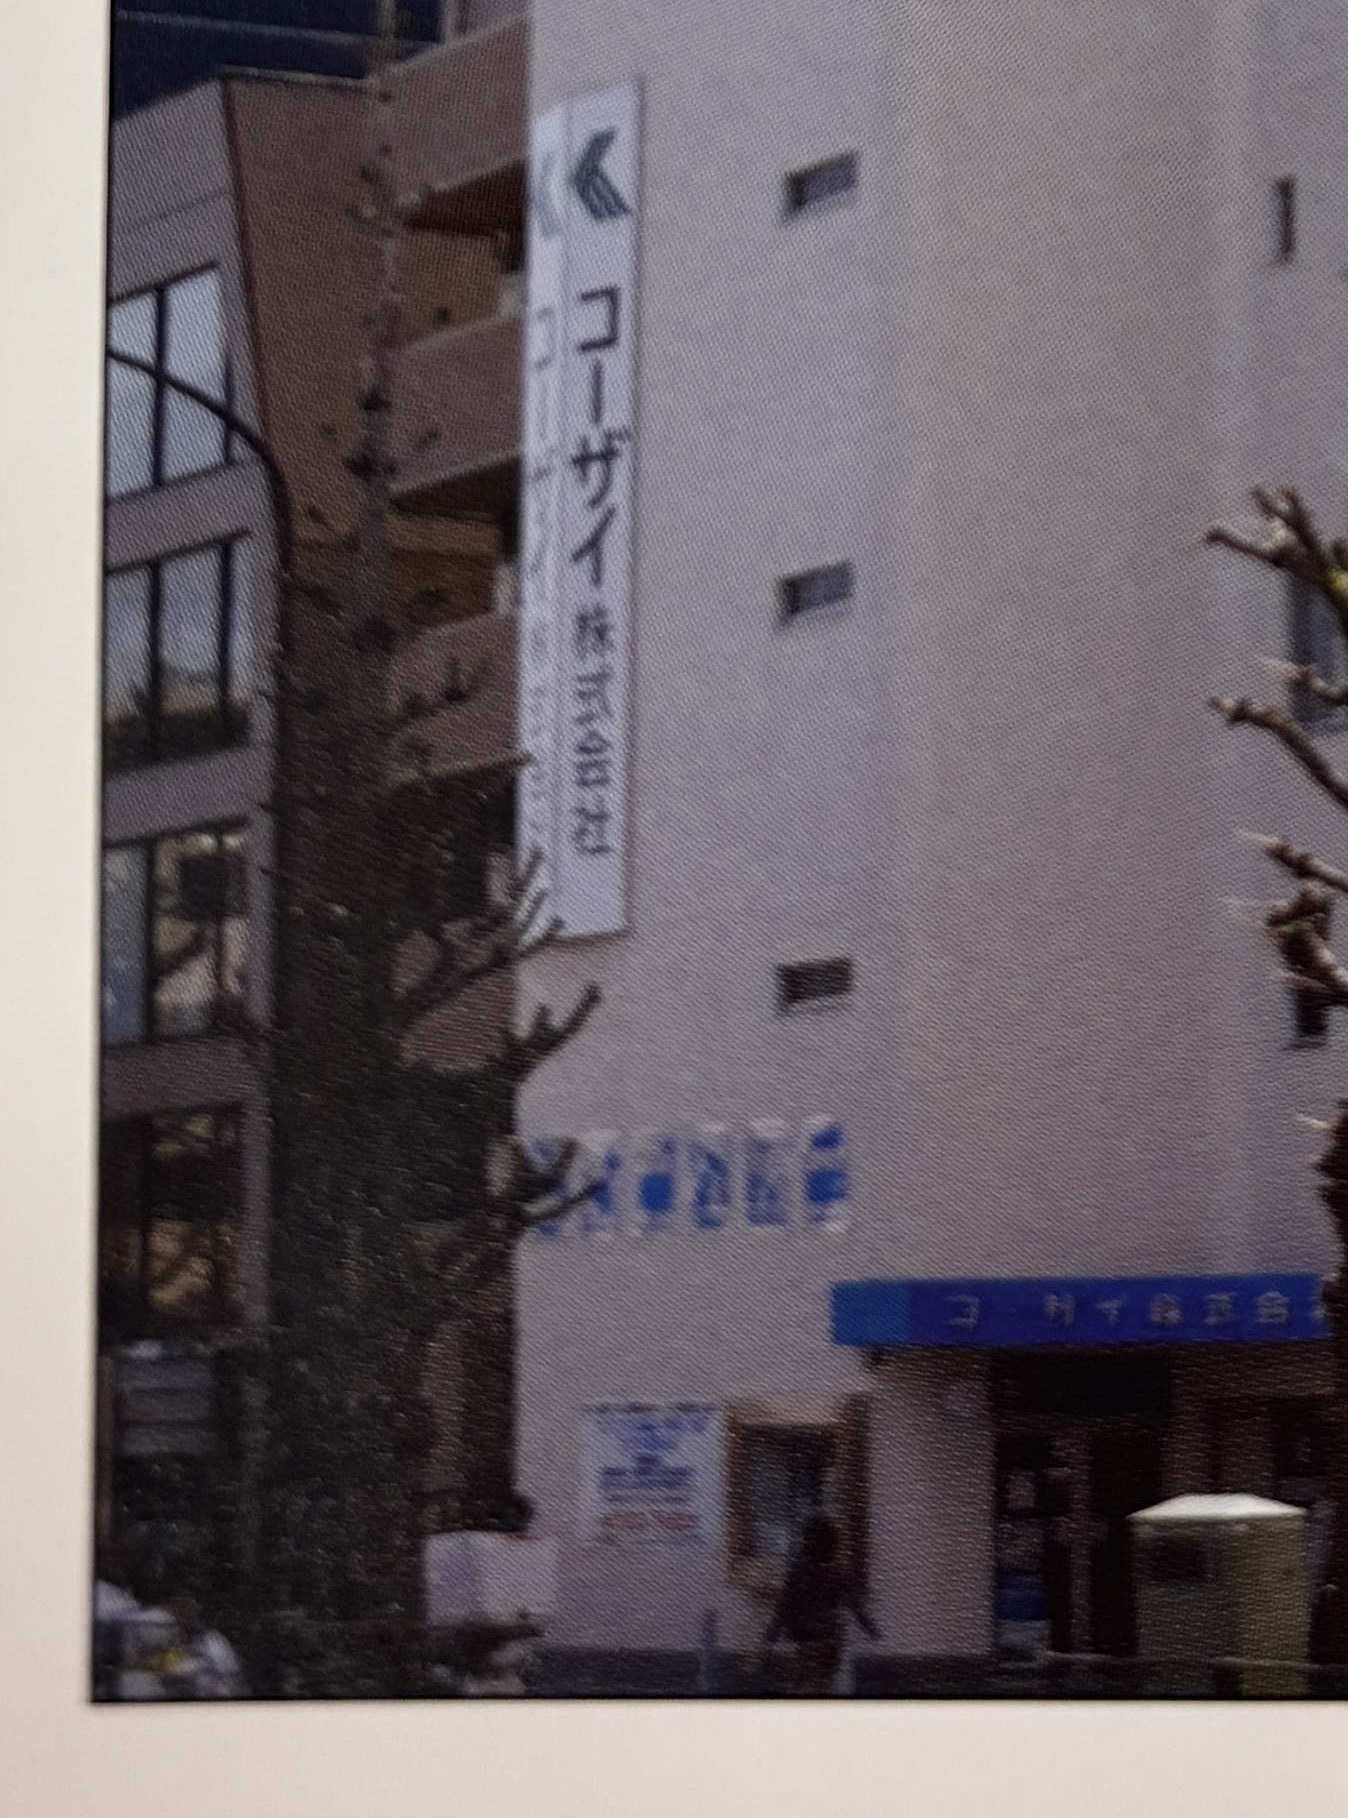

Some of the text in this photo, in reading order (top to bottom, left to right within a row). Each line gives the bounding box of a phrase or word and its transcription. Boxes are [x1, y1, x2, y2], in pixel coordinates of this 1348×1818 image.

[569, 285, 634, 858] コーザイ株式会社
